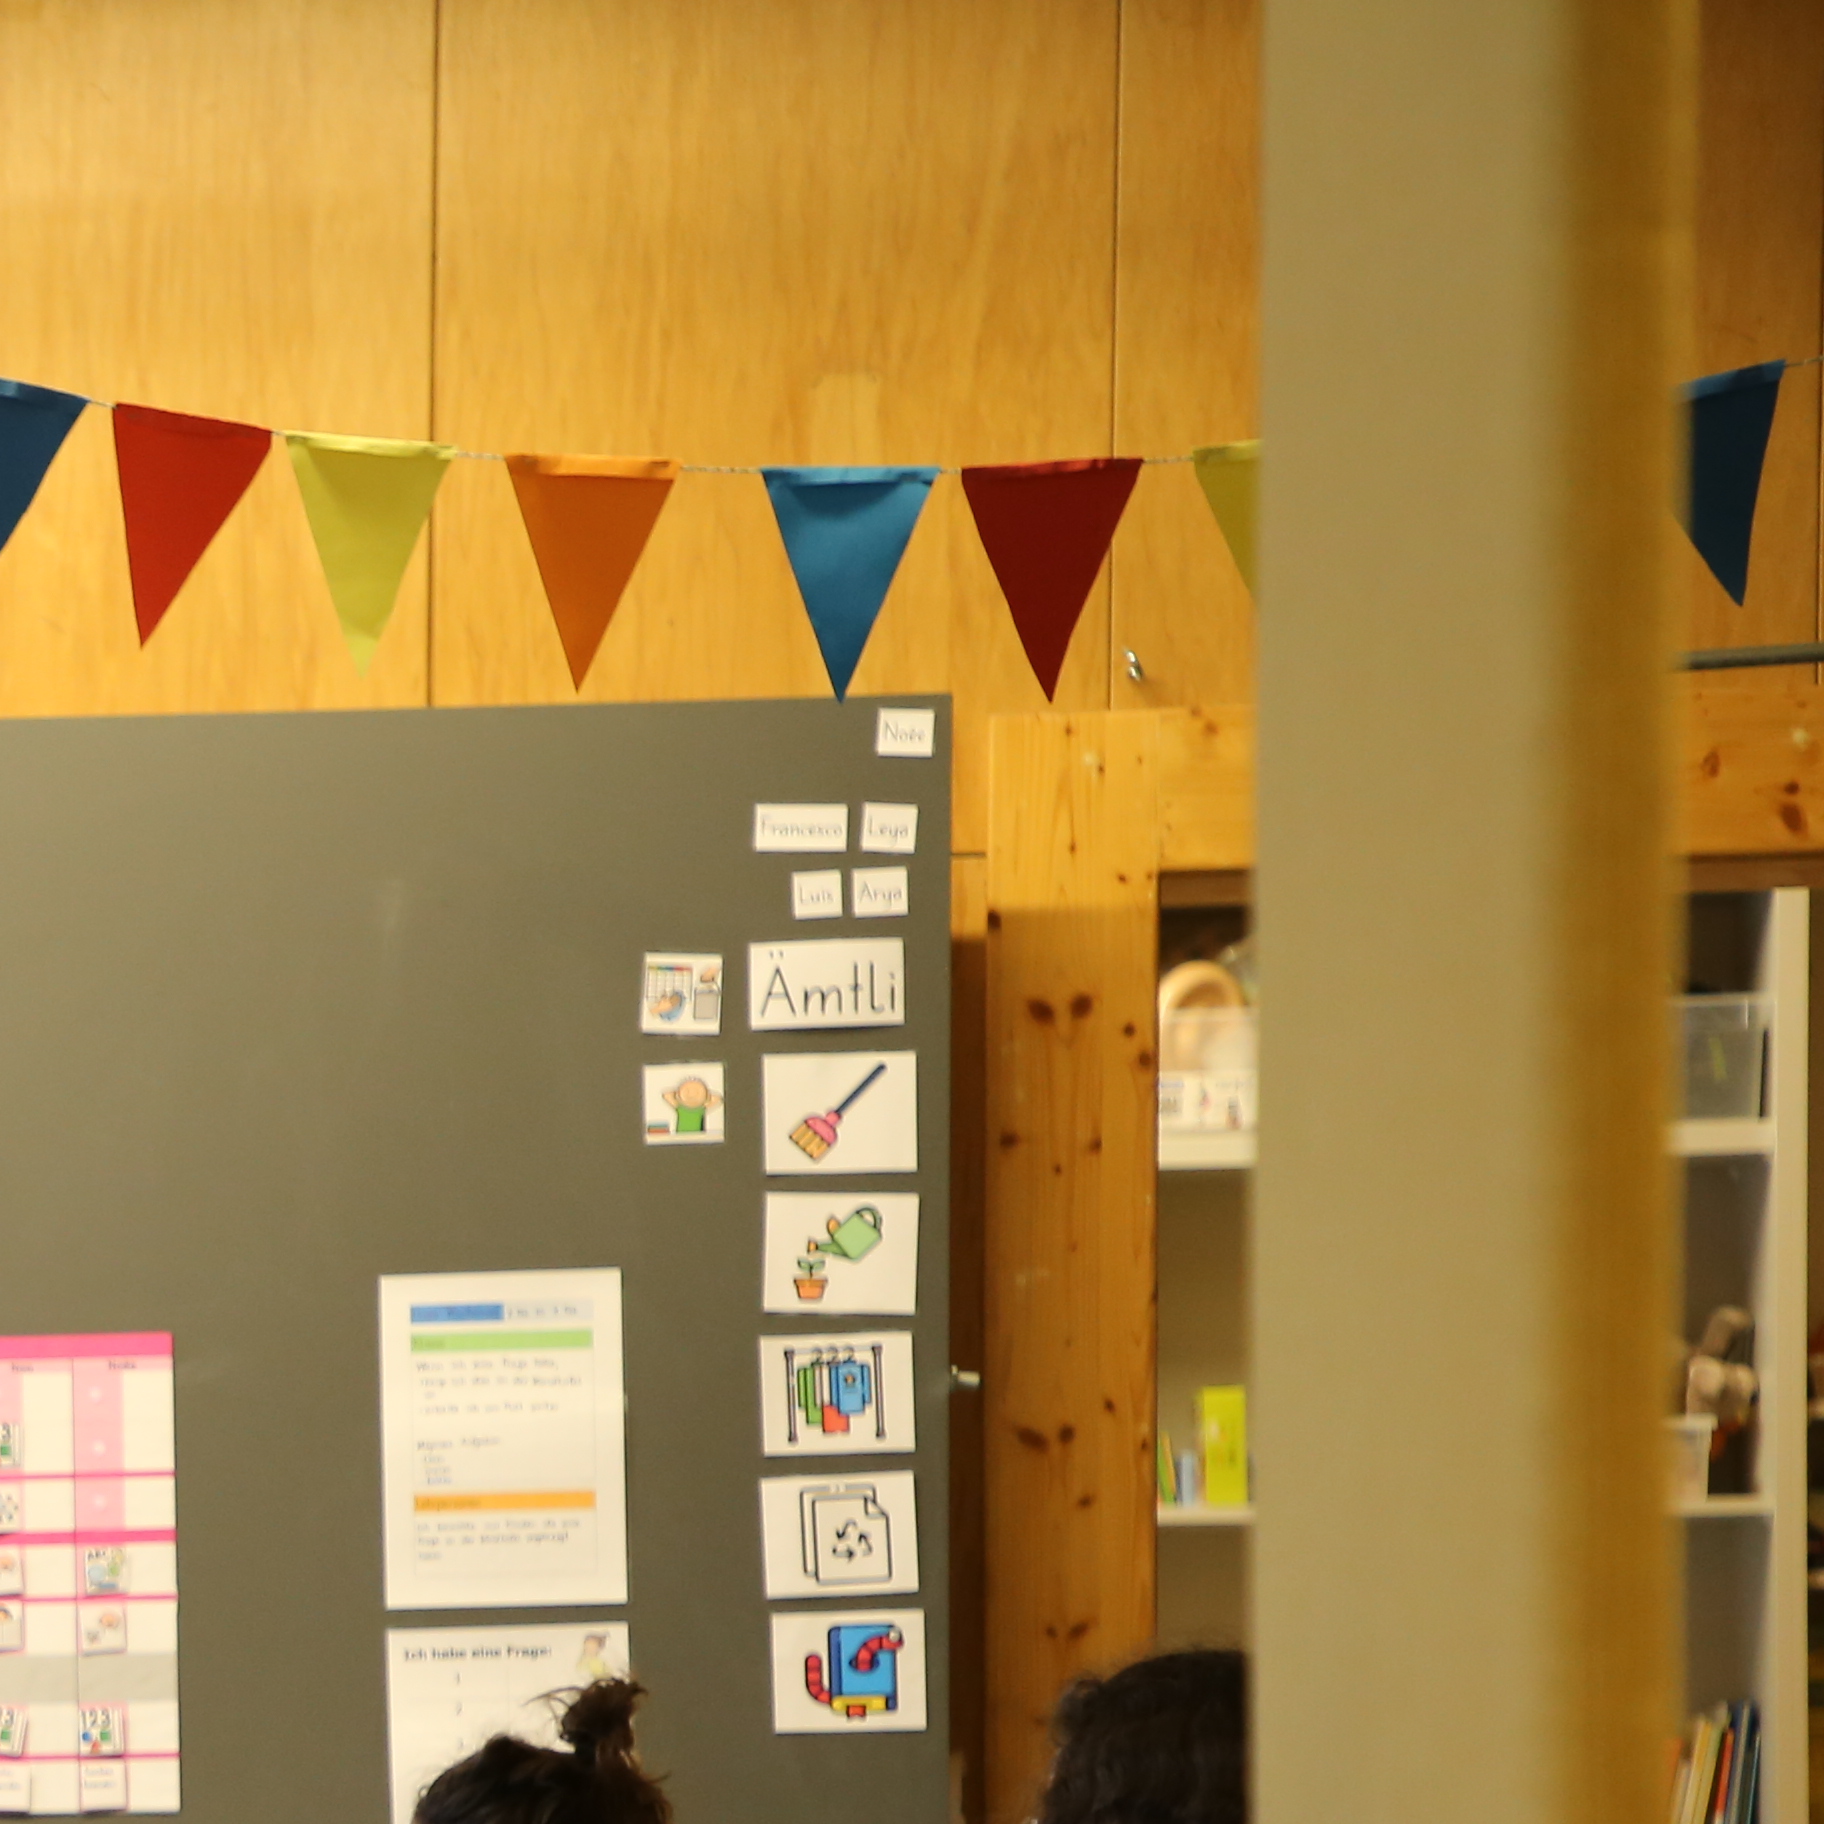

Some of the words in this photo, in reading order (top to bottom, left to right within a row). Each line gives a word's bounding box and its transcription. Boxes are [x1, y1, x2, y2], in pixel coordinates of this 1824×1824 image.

[759, 814, 843, 836] Francesco
[859, 880, 903, 911] Arya
[760, 951, 897, 1017] Ämtli
